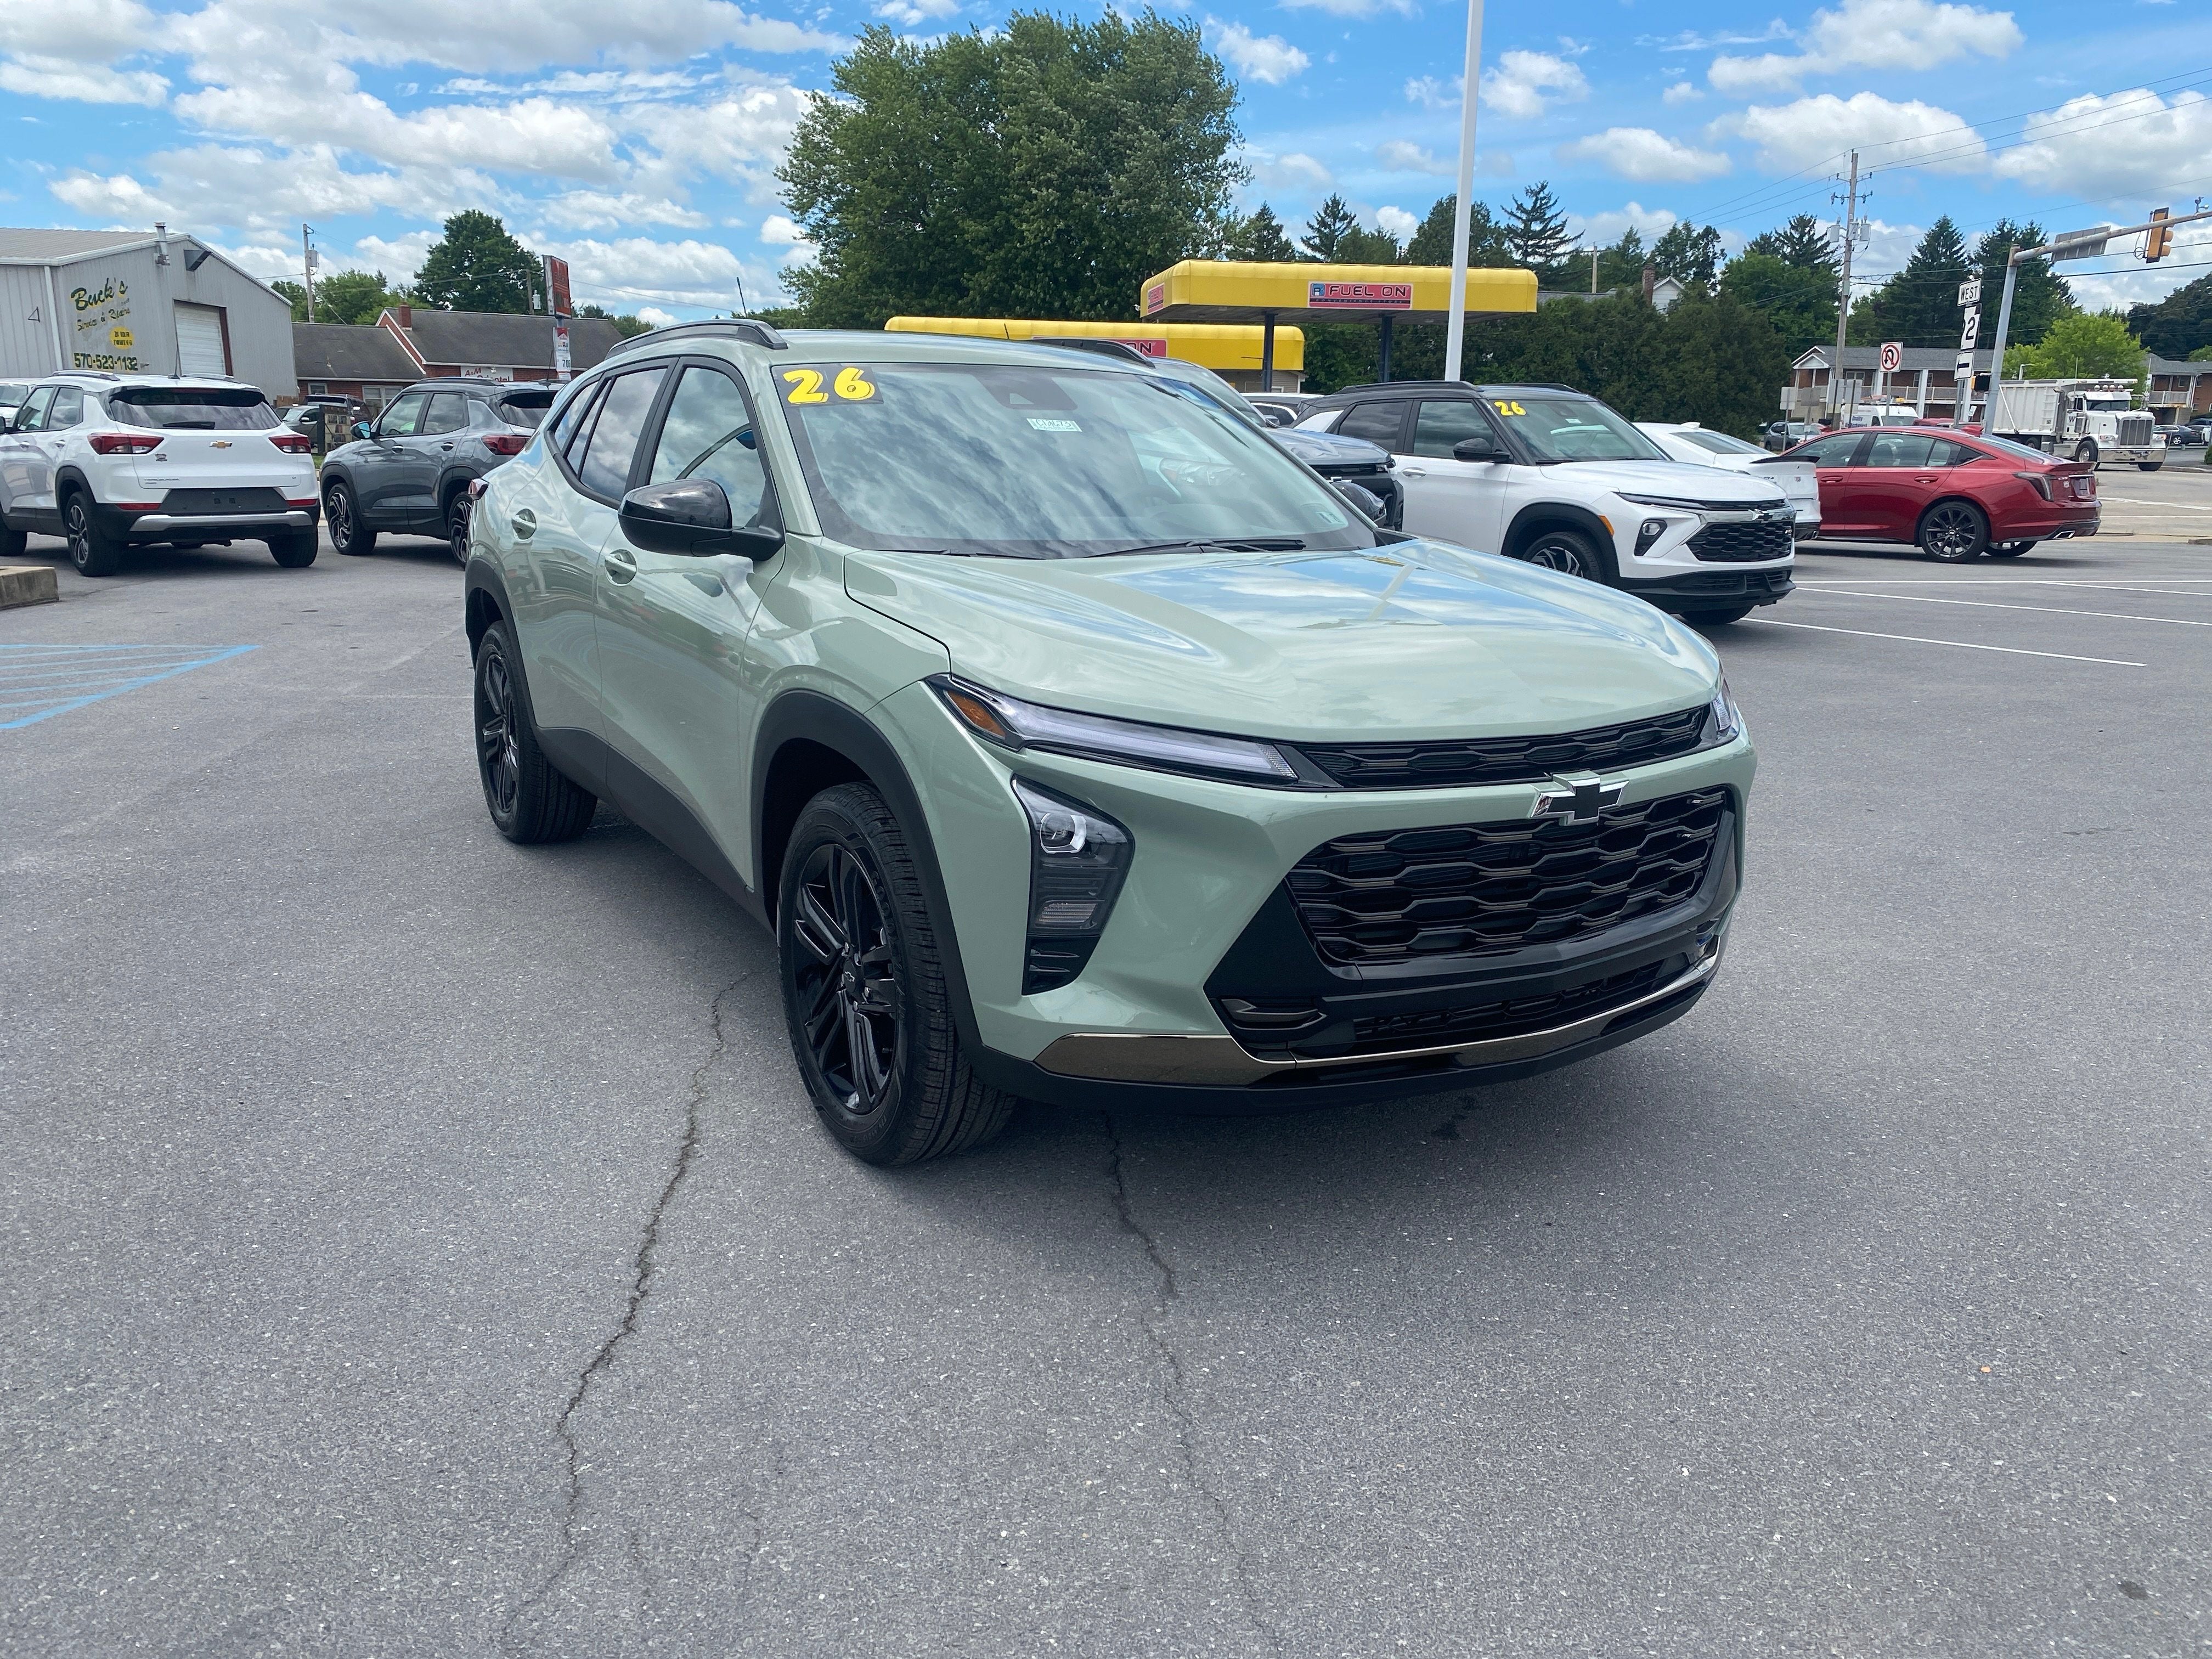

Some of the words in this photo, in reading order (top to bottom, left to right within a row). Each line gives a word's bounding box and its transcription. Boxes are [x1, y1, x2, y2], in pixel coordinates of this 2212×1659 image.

[70, 277, 128, 311] Buck's
[1329, 285, 1374, 297] FUEL
[1382, 286, 1406, 297] ON
[1961, 286, 1978, 301] WEST
[74, 353, 138, 371] 570-523-1132
[464, 367, 481, 376] A&M
[783, 367, 875, 404] 26
[1494, 401, 1526, 416] 26
